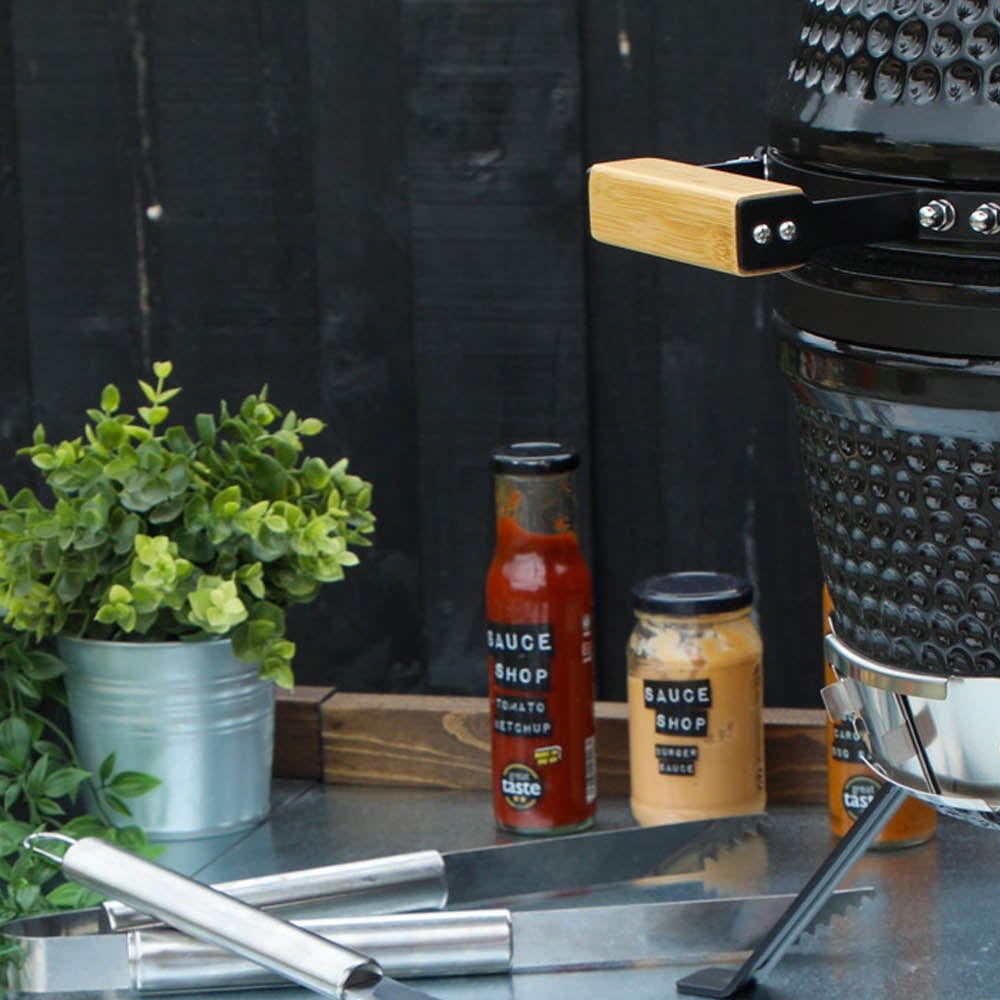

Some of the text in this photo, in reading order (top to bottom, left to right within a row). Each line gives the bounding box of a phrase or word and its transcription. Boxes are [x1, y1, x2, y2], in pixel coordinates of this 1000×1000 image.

[487, 629, 552, 651] SAUCE
[495, 663, 548, 684] SHOP
[644, 686, 709, 703] SAUCE
[496, 698, 545, 713] TOMATO
[656, 714, 706, 731] SHOP
[660, 764, 694, 774] SAUCE
[502, 779, 541, 796] taste
